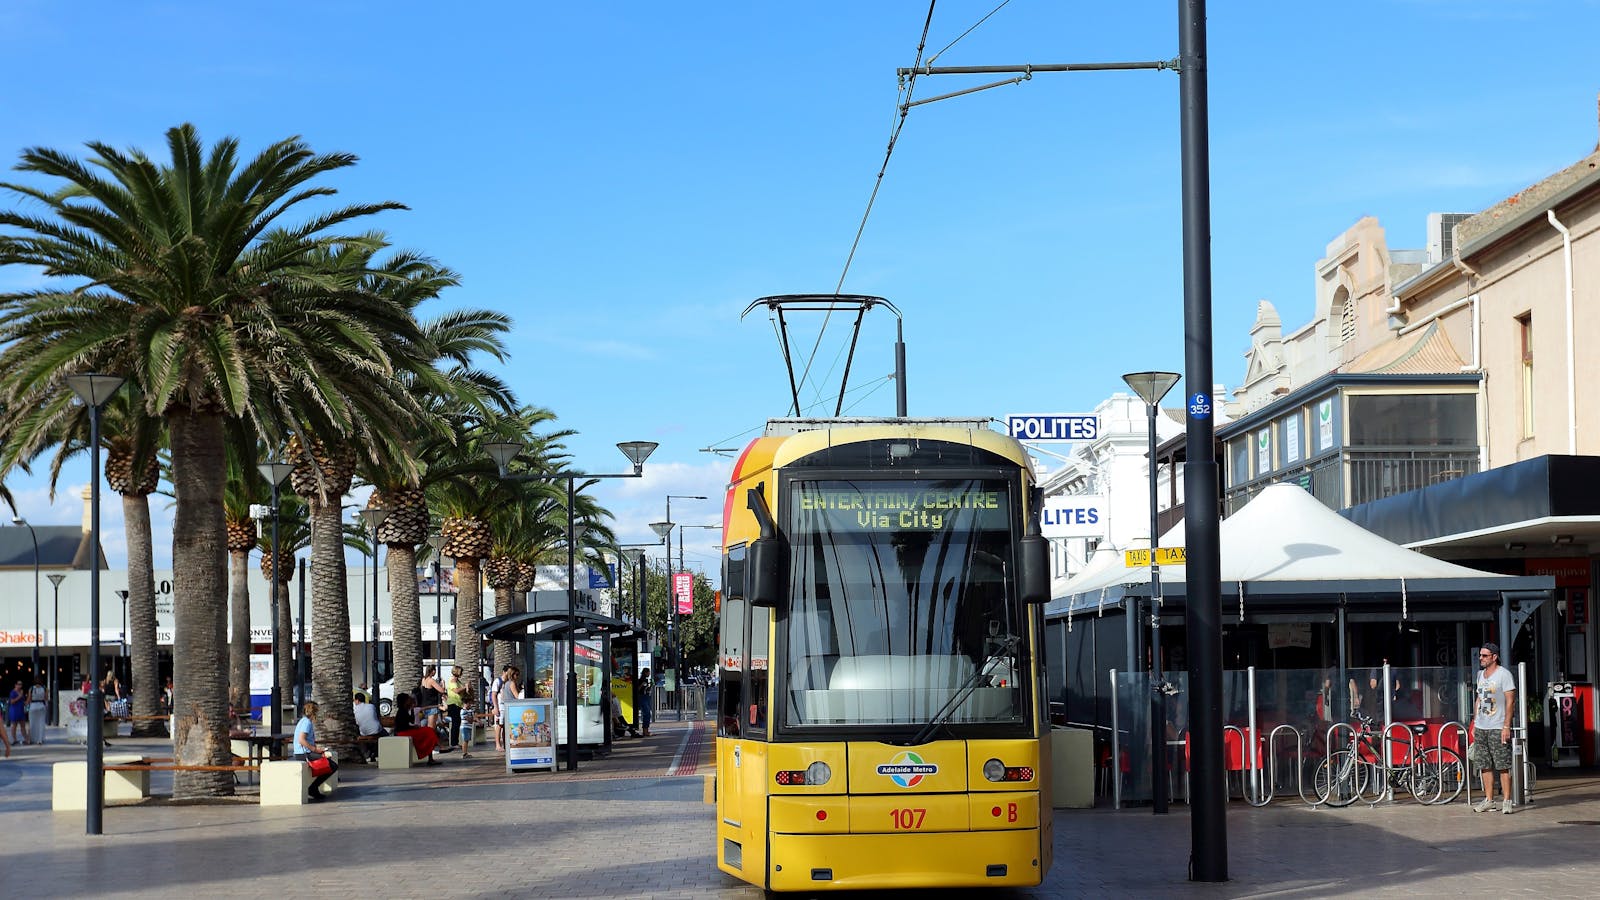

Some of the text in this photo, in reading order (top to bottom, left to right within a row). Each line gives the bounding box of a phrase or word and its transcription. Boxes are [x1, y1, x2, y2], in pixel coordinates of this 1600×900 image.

[1190, 404, 1210, 414] 352
[1196, 395, 1204, 404] G
[1012, 417, 1096, 439] POLITES
[857, 510, 944, 529] Via City
[1129, 548, 1147, 561] TAXIS
[889, 808, 927, 829] 107
[1007, 802, 1018, 823] B
